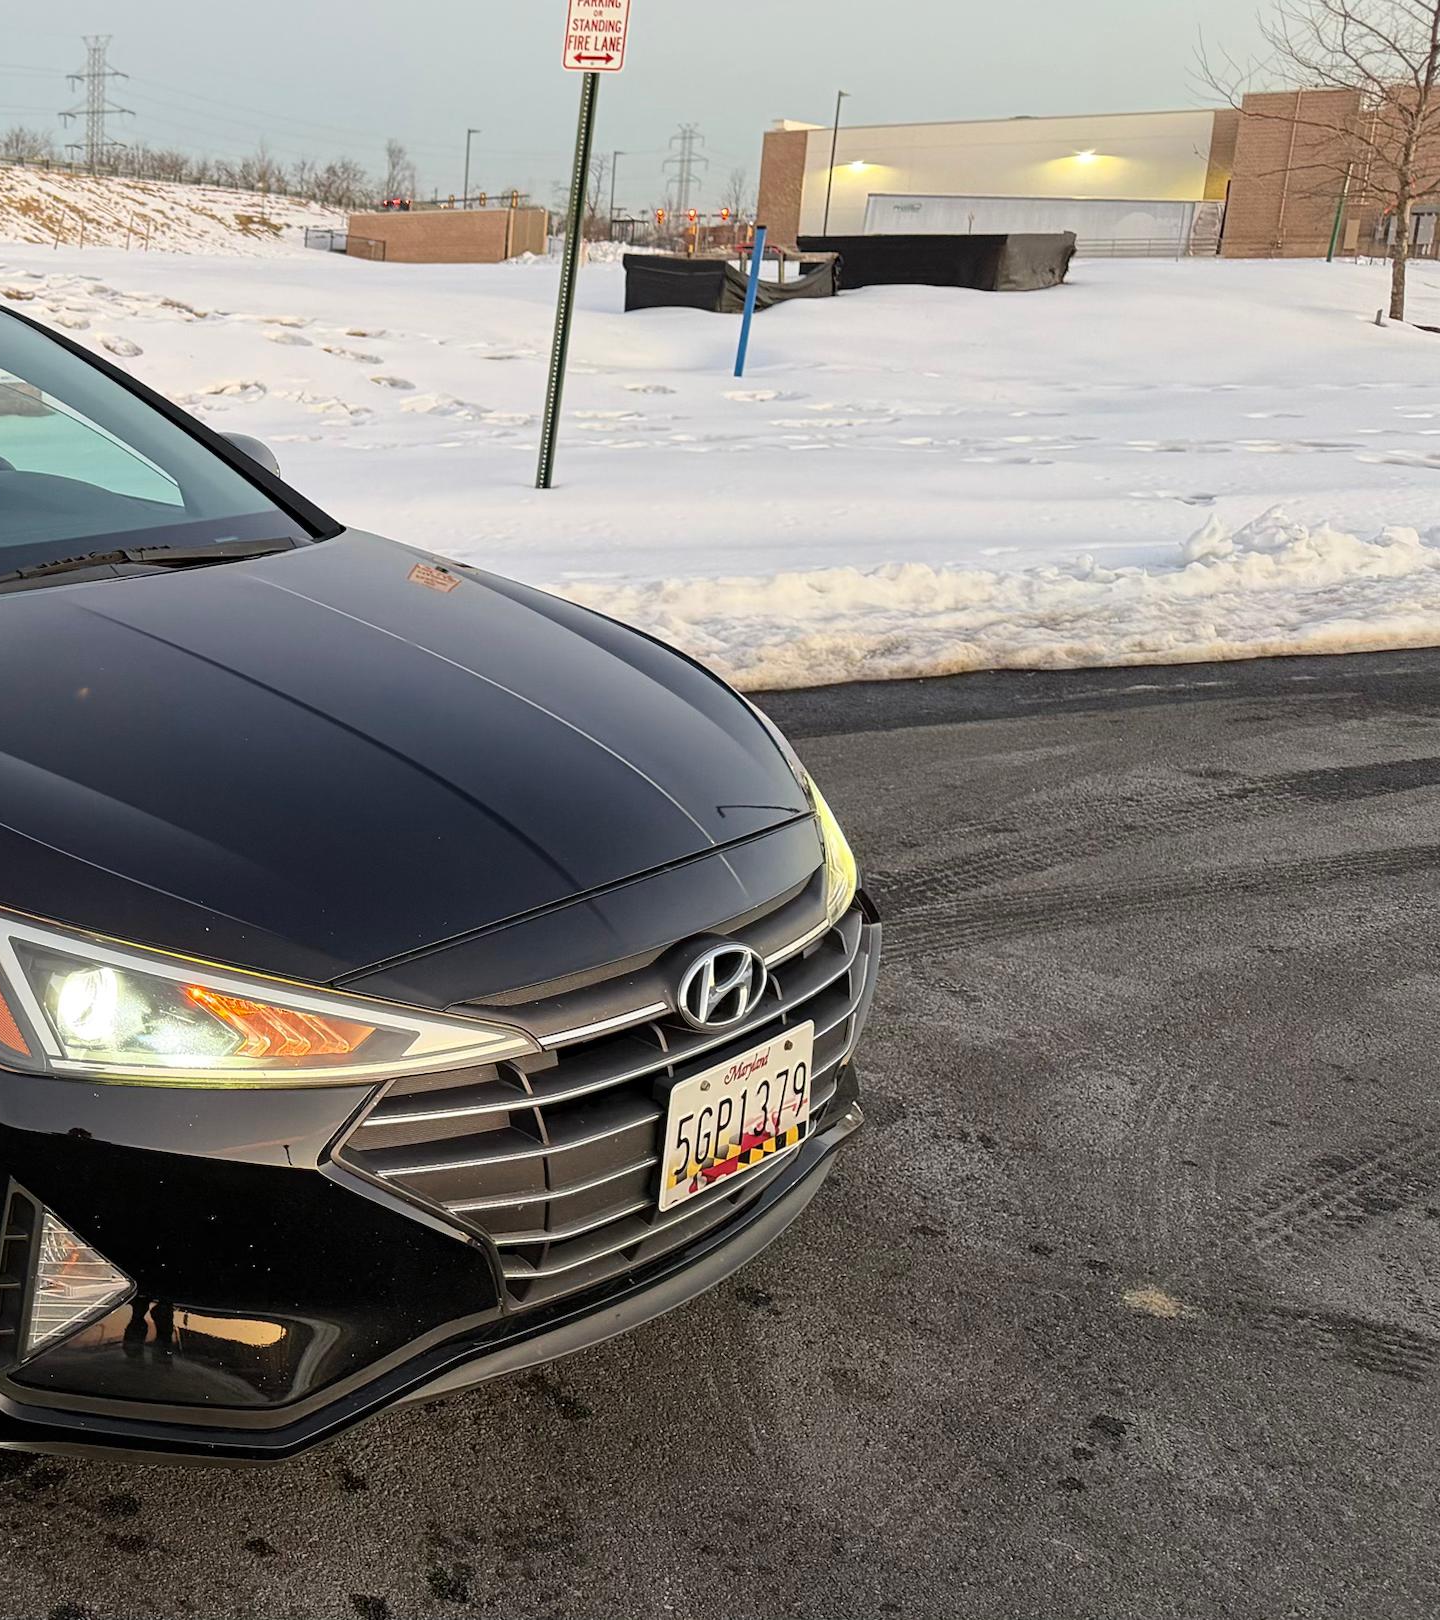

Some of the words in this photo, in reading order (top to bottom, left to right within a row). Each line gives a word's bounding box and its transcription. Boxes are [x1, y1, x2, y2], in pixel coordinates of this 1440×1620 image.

[572, 18, 622, 33] STANDING
[568, 35, 591, 51] FIRE
[594, 36, 622, 52] LANE
[724, 1047, 770, 1085] Maryland
[673, 1061, 806, 1176] 5GP1379
